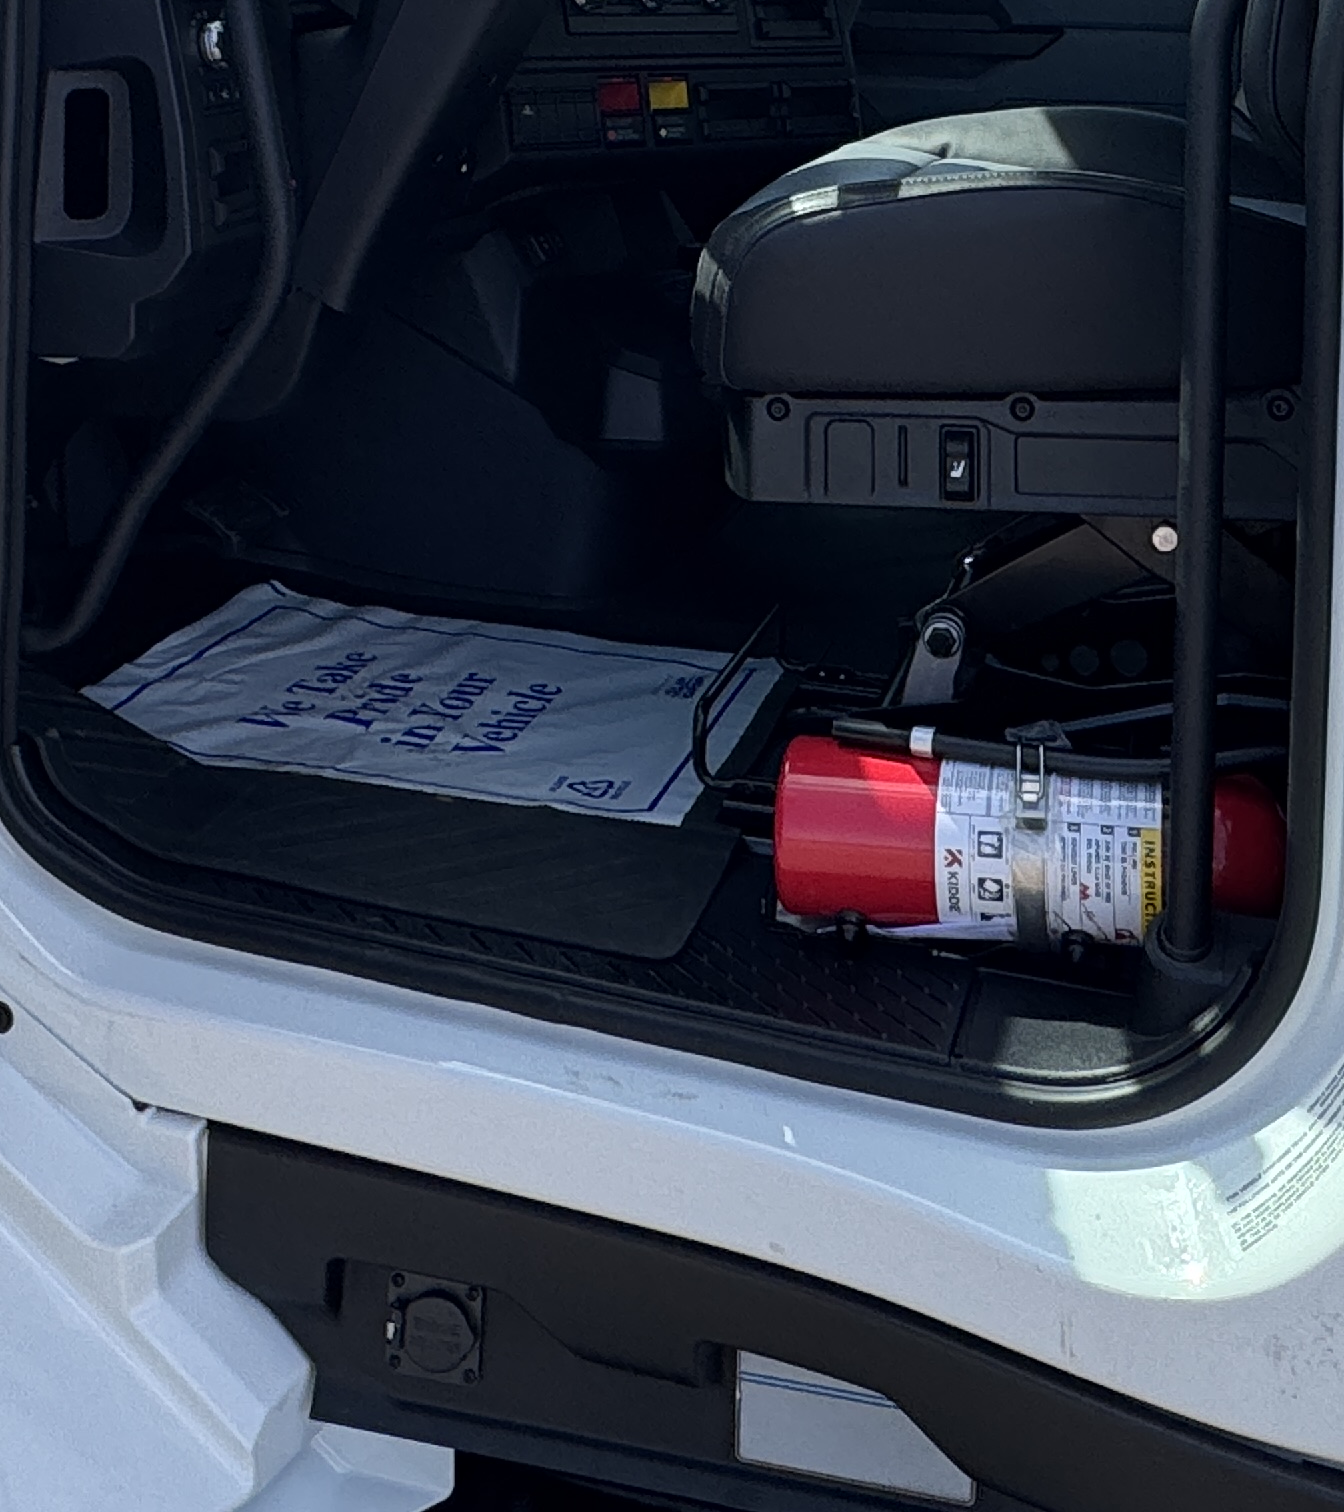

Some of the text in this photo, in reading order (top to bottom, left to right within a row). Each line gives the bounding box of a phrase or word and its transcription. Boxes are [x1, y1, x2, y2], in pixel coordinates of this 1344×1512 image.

[286, 650, 378, 696] Take
[323, 672, 424, 731] Pride
[380, 672, 497, 749] in Your
[450, 682, 564, 752] Vehicle
[947, 870, 962, 915] KIDDE
